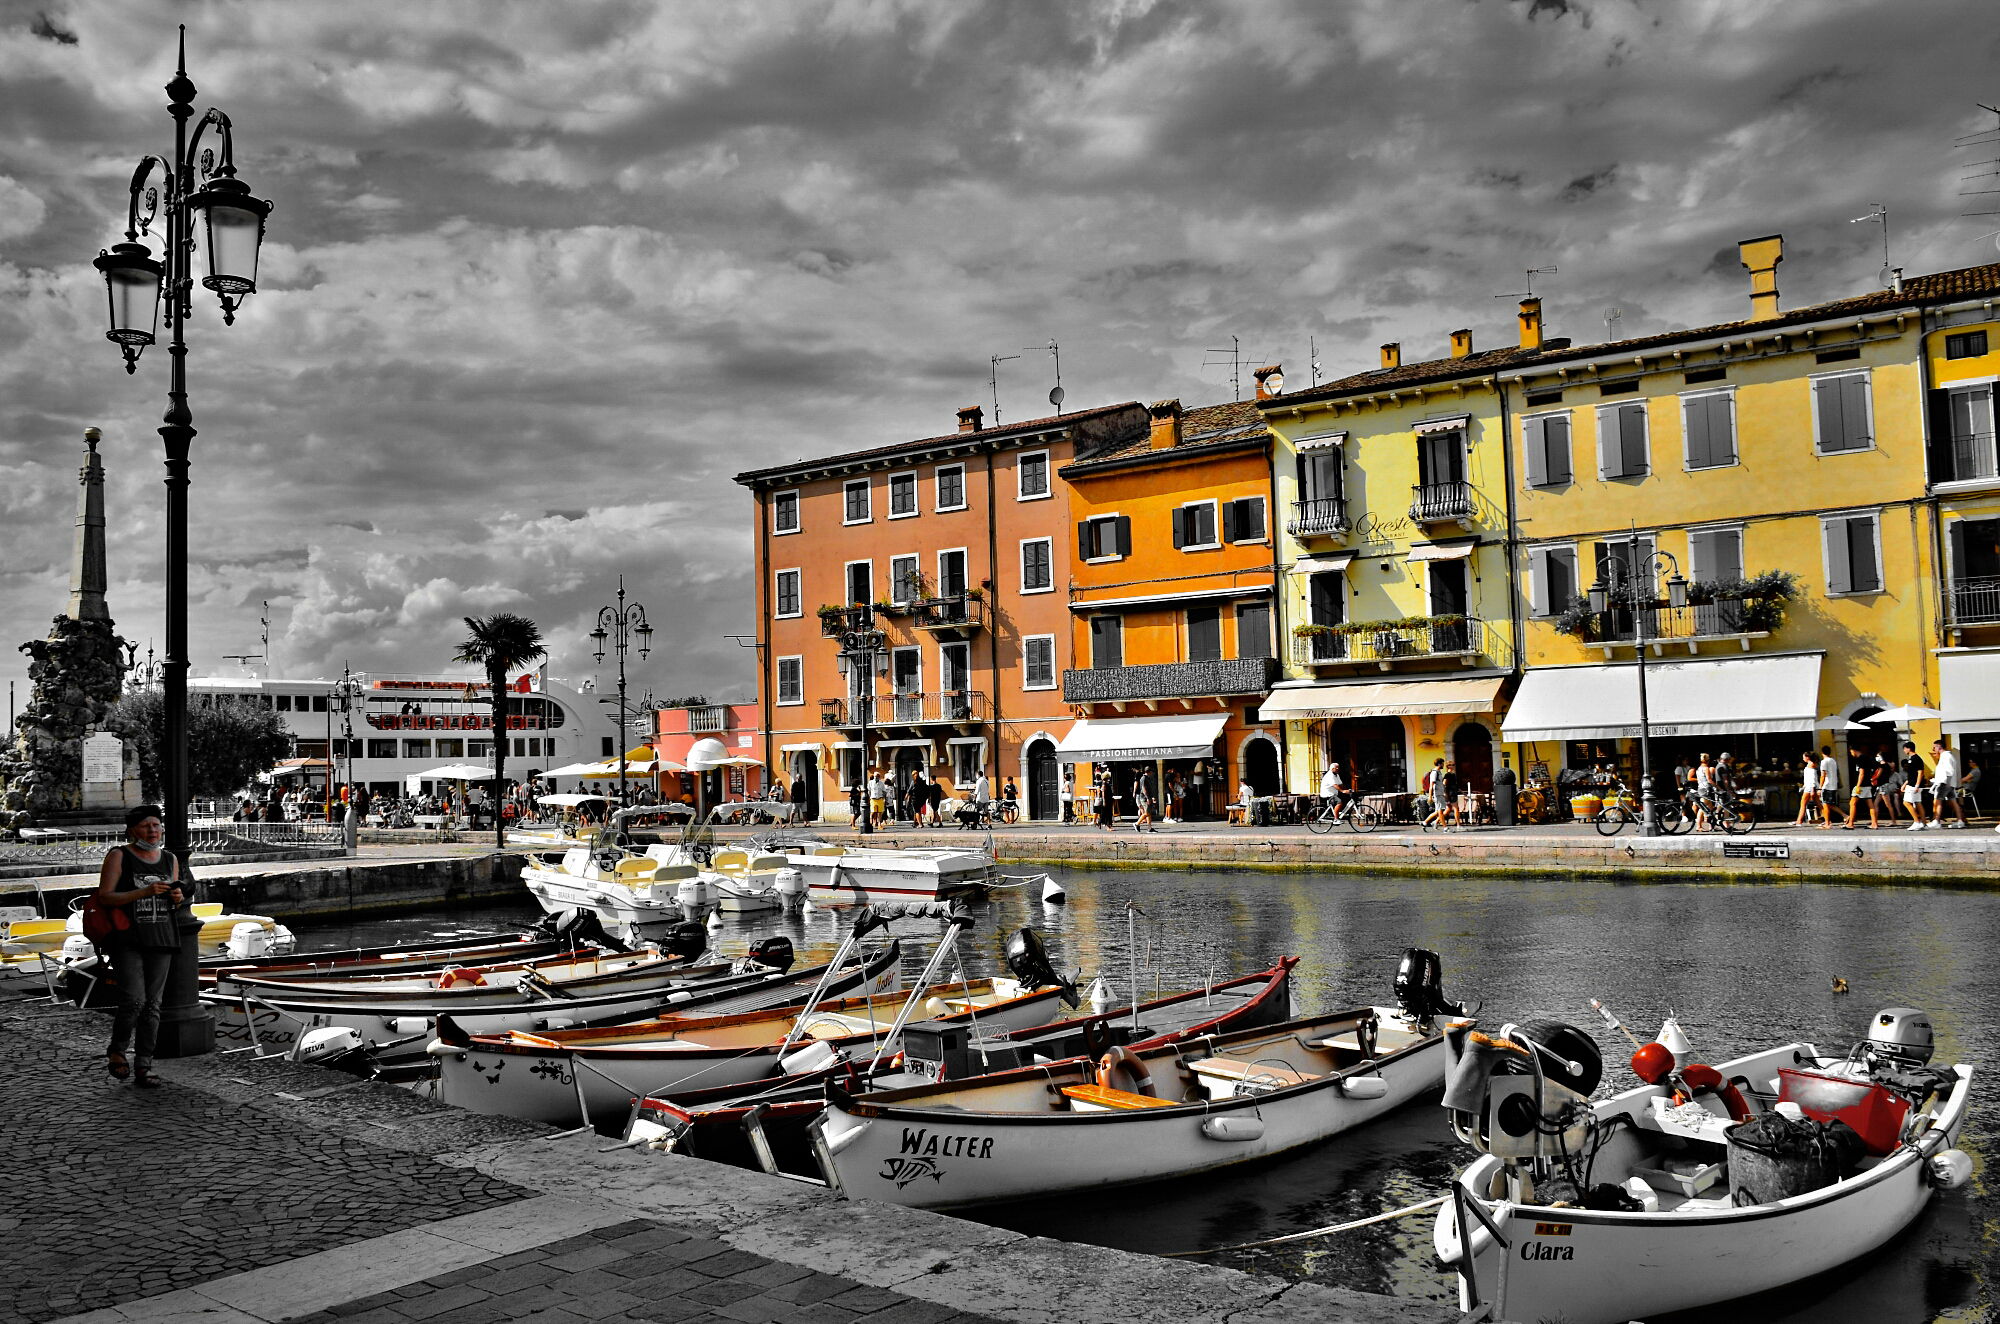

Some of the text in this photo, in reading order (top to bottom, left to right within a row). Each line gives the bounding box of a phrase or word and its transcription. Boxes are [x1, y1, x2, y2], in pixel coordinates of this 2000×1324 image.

[1356, 511, 1412, 536] Oreste
[1302, 708, 1353, 718] Ristorante
[1361, 707, 1375, 716] da
[1381, 706, 1410, 715] Oreste
[1622, 727, 1651, 737] DROGHEA
[1090, 747, 1173, 758] PASSIONEITALIANA
[304, 1042, 325, 1055] SELVA
[900, 1127, 994, 1159] WALTER
[1520, 1241, 1575, 1261] Clara
